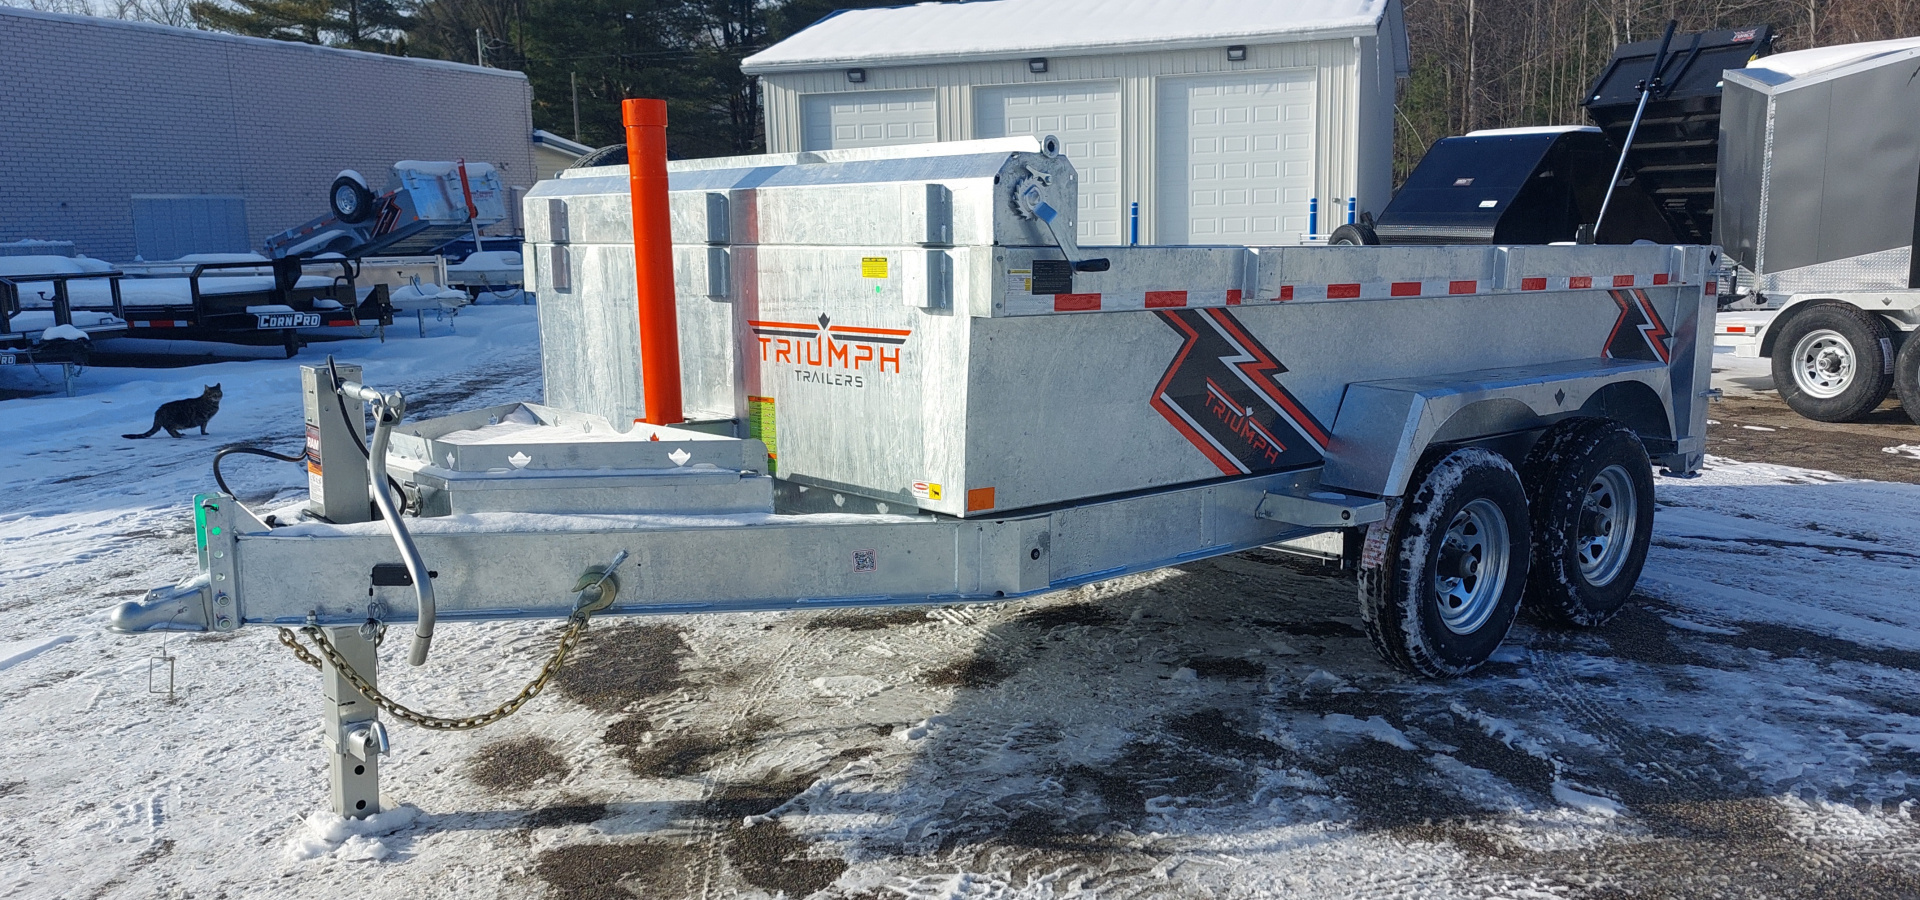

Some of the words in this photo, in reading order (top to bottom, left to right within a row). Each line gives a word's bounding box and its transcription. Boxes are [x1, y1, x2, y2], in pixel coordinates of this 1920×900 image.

[757, 334, 901, 374] TRIUMPH
[794, 369, 863, 388] TRAILERS
[1205, 390, 1279, 465] TRIUMPH
